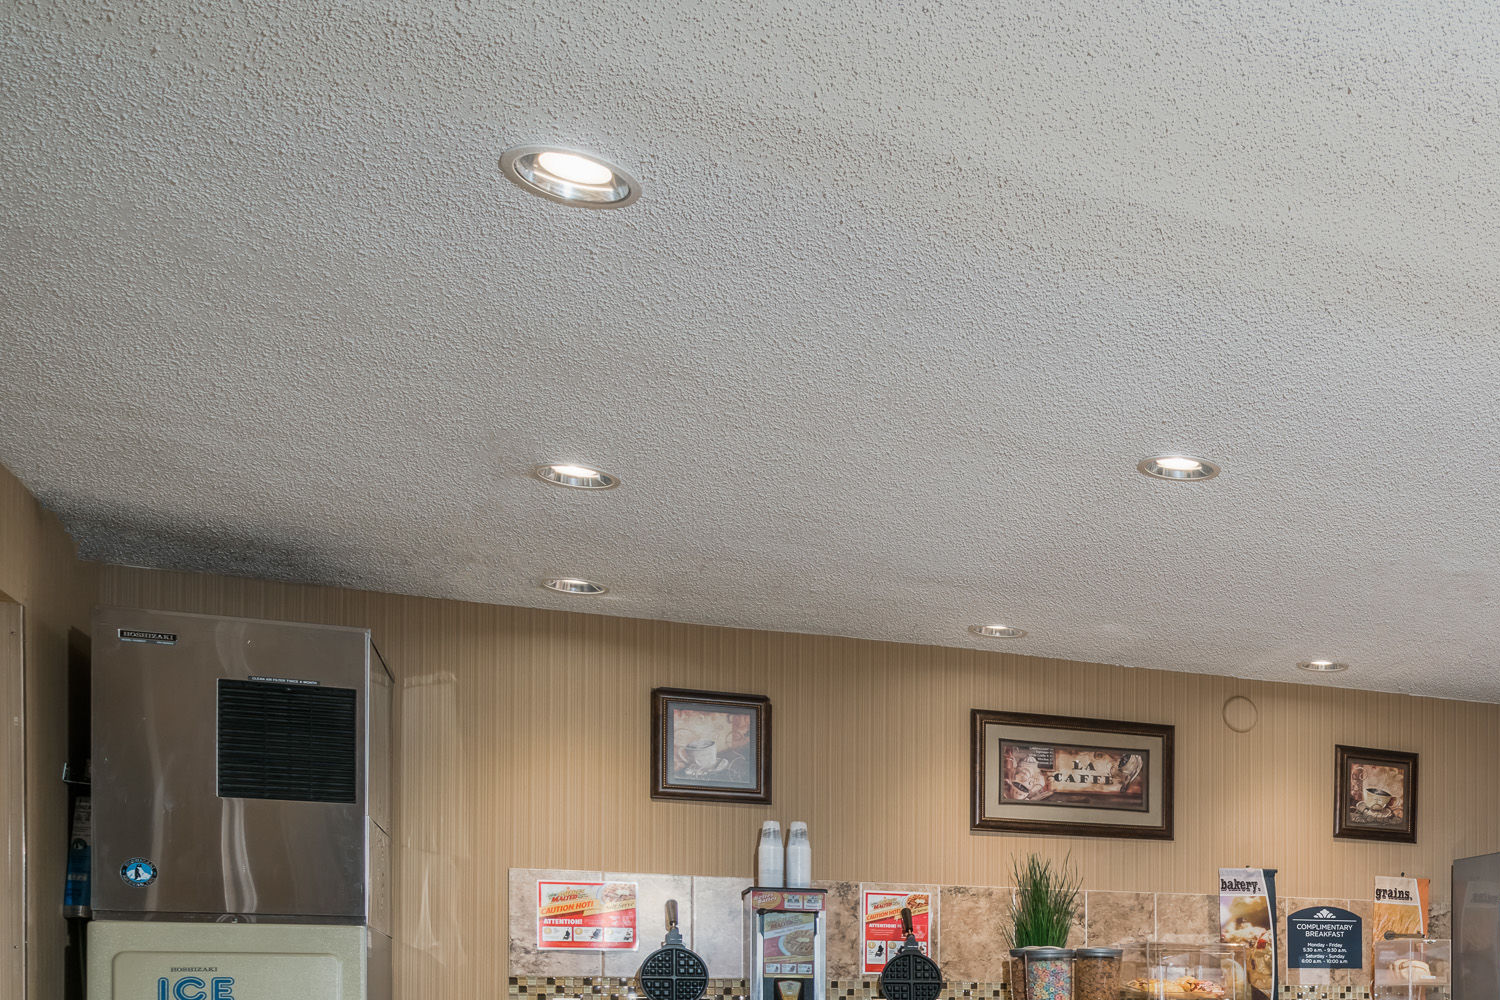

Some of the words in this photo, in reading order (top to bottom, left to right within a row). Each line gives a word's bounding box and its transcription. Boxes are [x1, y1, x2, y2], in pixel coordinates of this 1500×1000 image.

[123, 631, 174, 640] HOSHIZAKI
[1072, 760, 1096, 771] LA
[1220, 878, 1261, 895] bakery.
[1375, 888, 1412, 901] grains.
[541, 902, 575, 915] CAUTION
[575, 900, 594, 910] HOT!
[867, 911, 889, 920] CAUTION
[1296, 923, 1353, 931] COMPLIMENTARY
[1305, 930, 1345, 938] BREAKFAST
